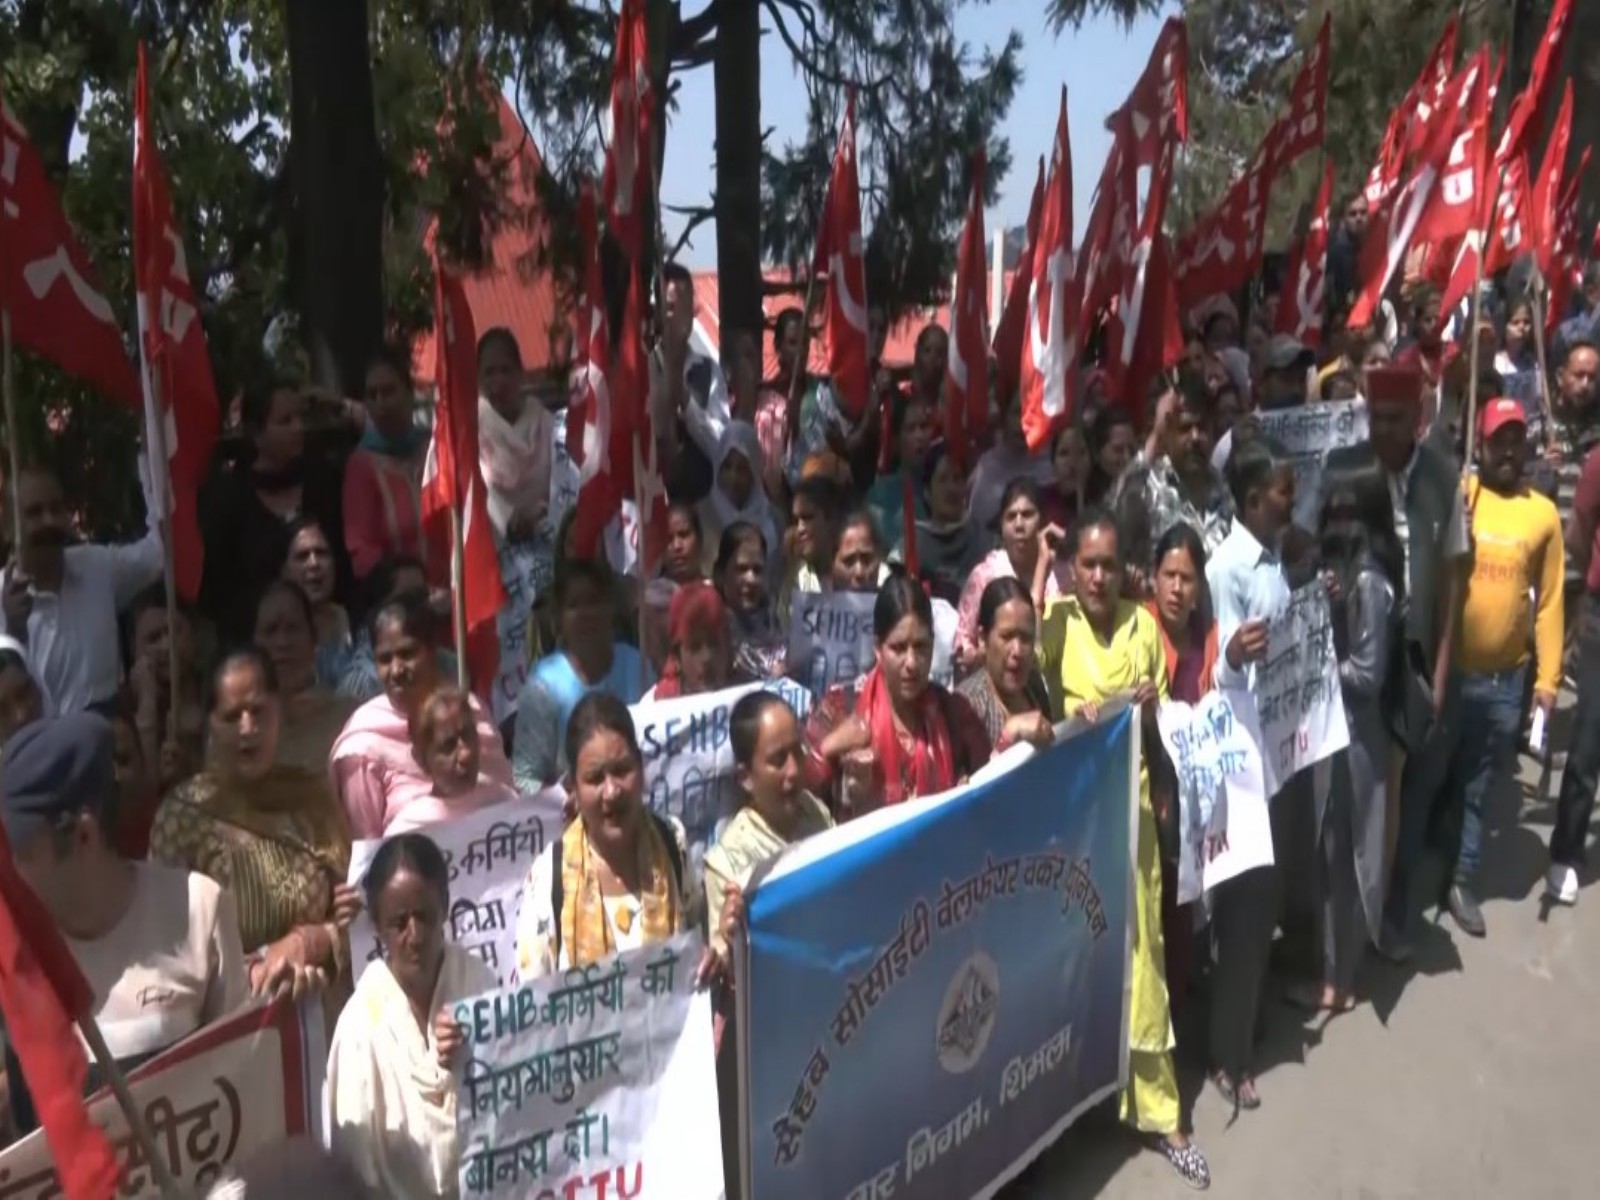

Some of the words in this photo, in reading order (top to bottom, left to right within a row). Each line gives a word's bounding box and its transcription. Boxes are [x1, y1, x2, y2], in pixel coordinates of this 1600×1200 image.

[643, 703, 729, 760] SEHB
[640, 948, 680, 996] को
[462, 1031, 623, 1120] नियमानुसार
[999, 1022, 1074, 1107] शिमला
[462, 1129, 554, 1194] बोनस
